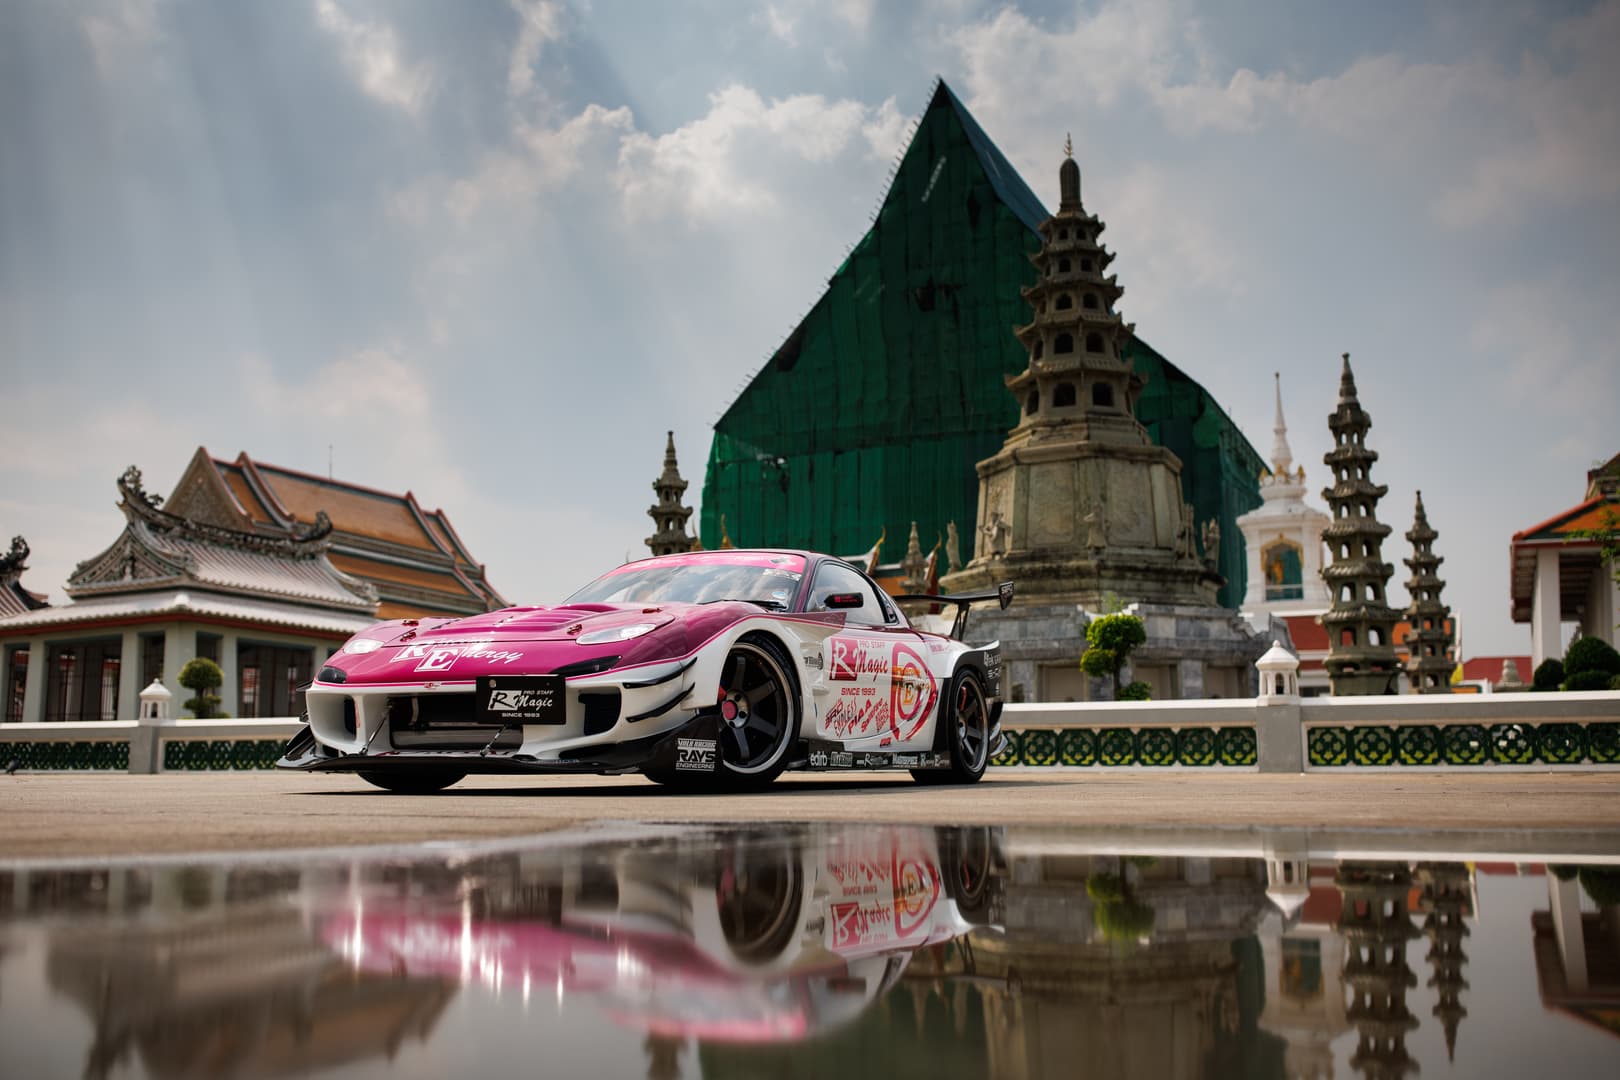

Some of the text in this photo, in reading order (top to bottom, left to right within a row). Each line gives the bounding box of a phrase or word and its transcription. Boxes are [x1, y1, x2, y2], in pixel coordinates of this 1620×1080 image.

[841, 687, 877, 696] SINCE 1993
[847, 698, 872, 735] PIAA
[680, 749, 717, 763] RAYS
